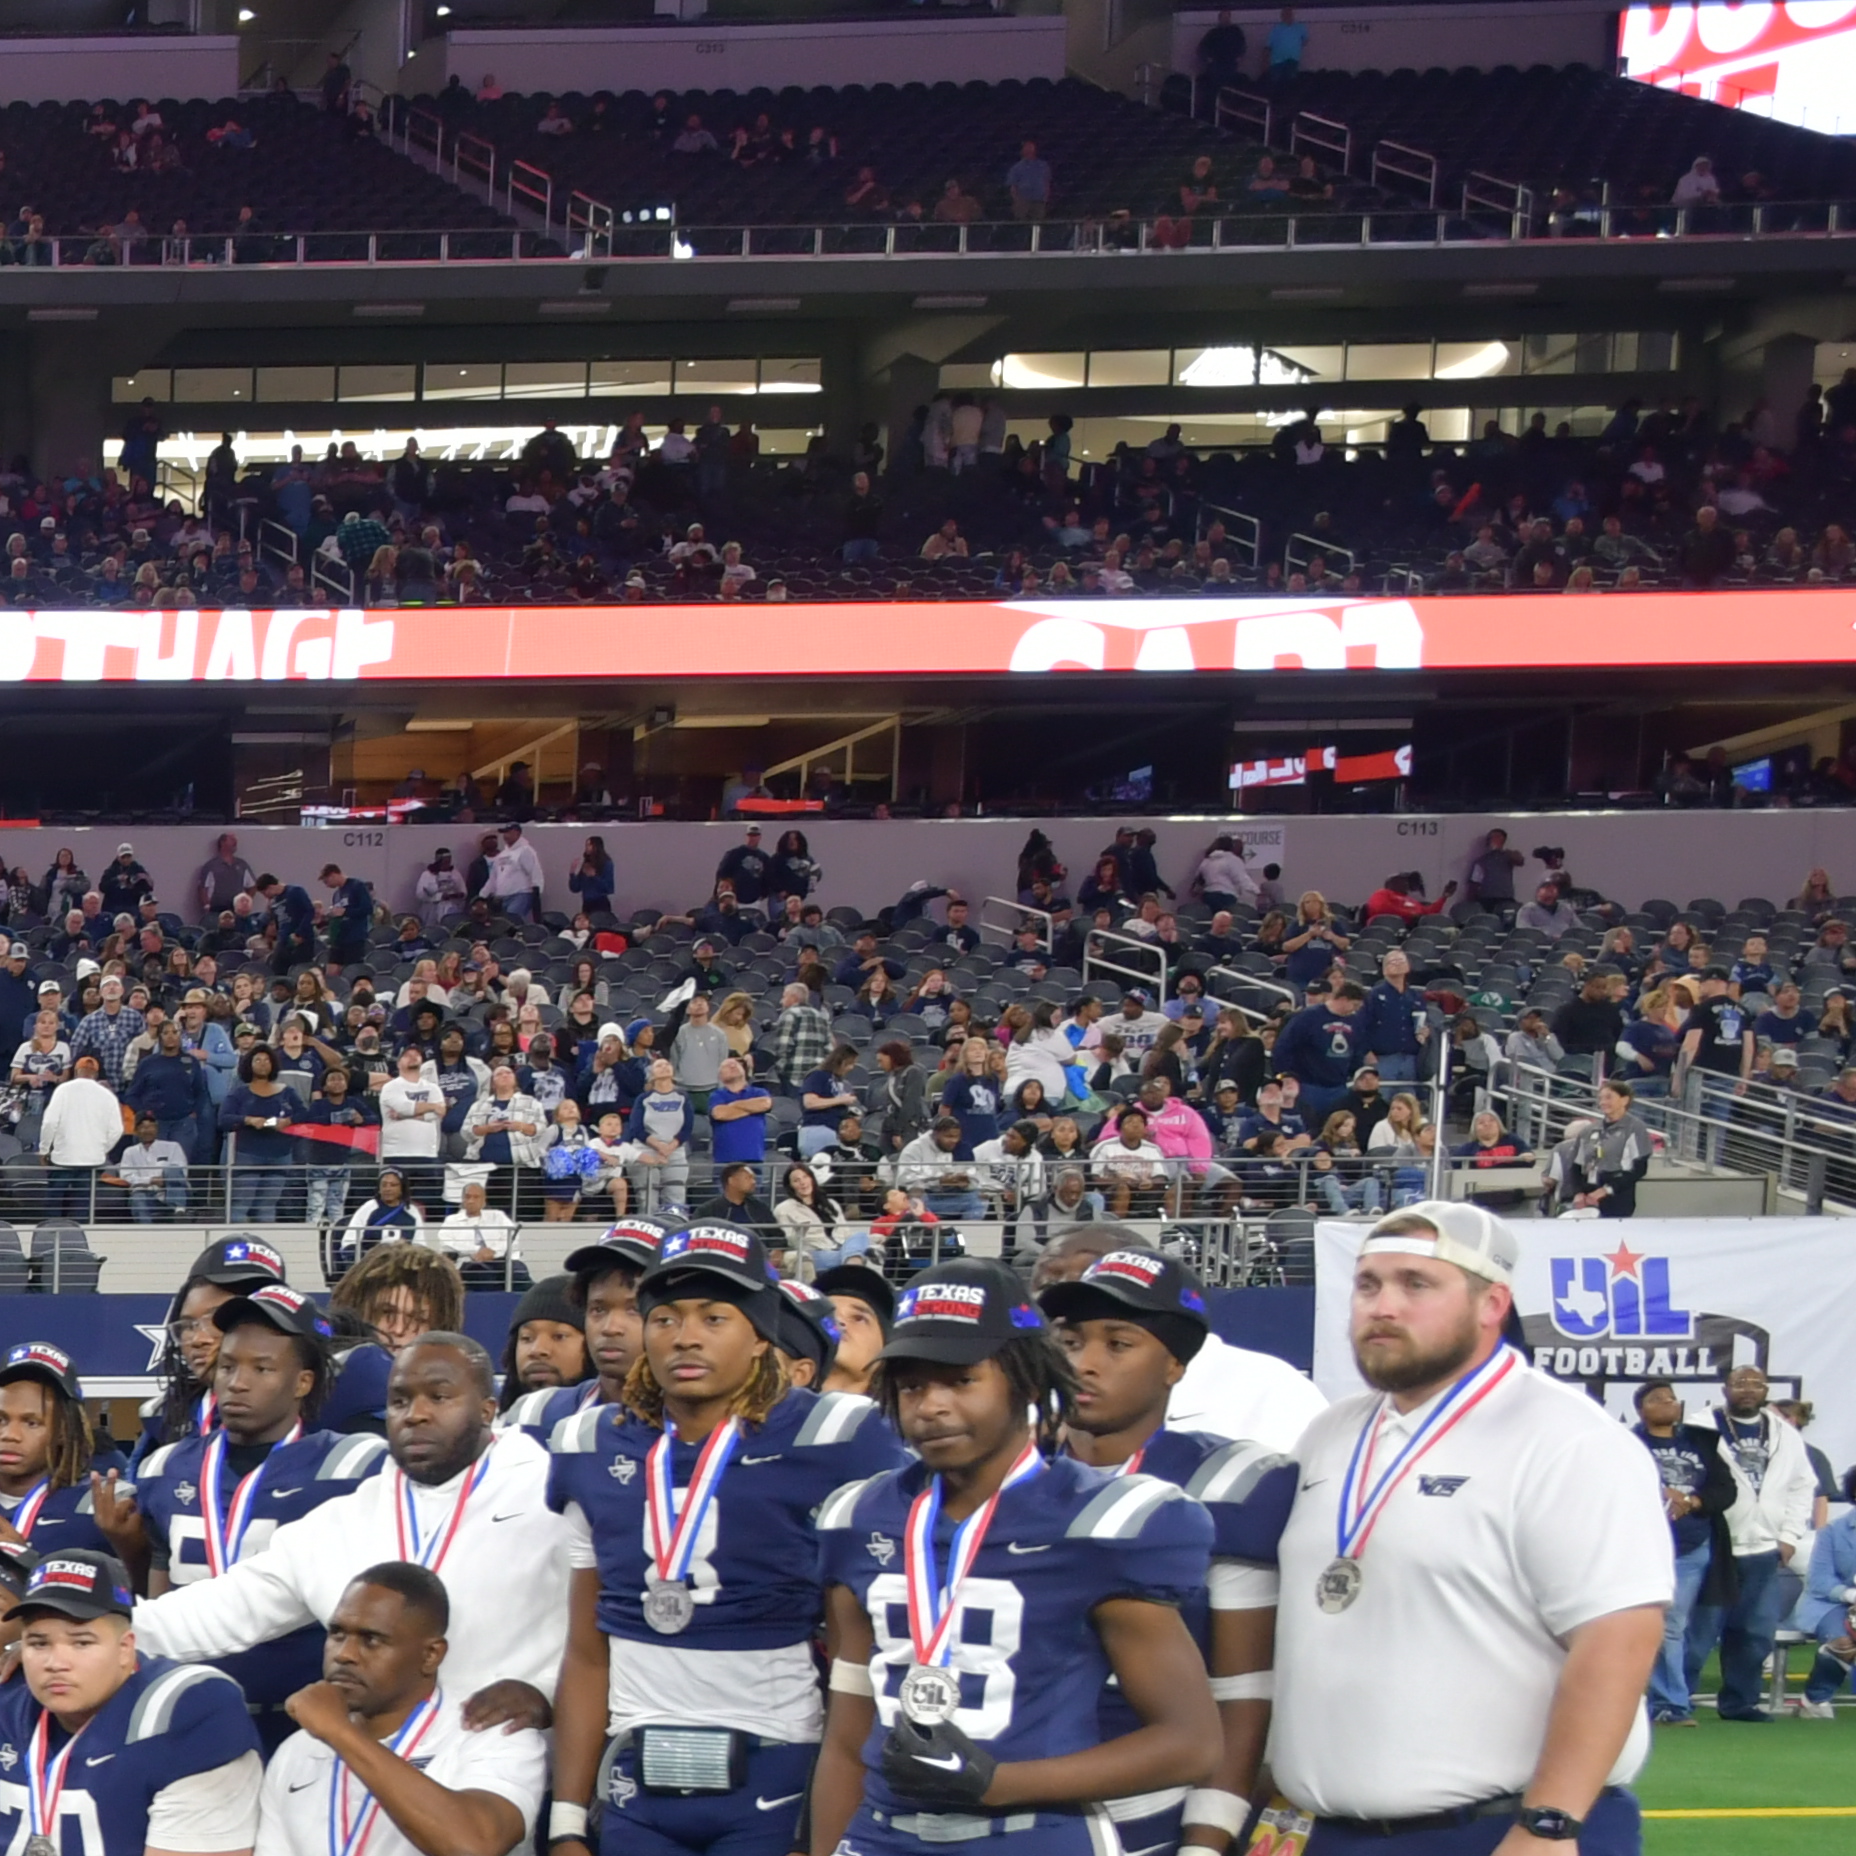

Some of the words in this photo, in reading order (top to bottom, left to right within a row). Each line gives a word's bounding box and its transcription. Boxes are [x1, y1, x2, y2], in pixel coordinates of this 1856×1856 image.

[343, 832, 384, 847] C112
[1396, 821, 1438, 837] C113
[614, 1217, 664, 1239] TEXAS
[688, 1226, 750, 1248] TEXAS
[1098, 1253, 1165, 1277] TEXAS
[914, 1282, 984, 1306] TEXAS
[1532, 1346, 1719, 1376] FOOTBALL
[1416, 1473, 1471, 1499] WOS
[44, 1560, 98, 1581] TEXAS
[866, 1573, 1025, 1740] 88
